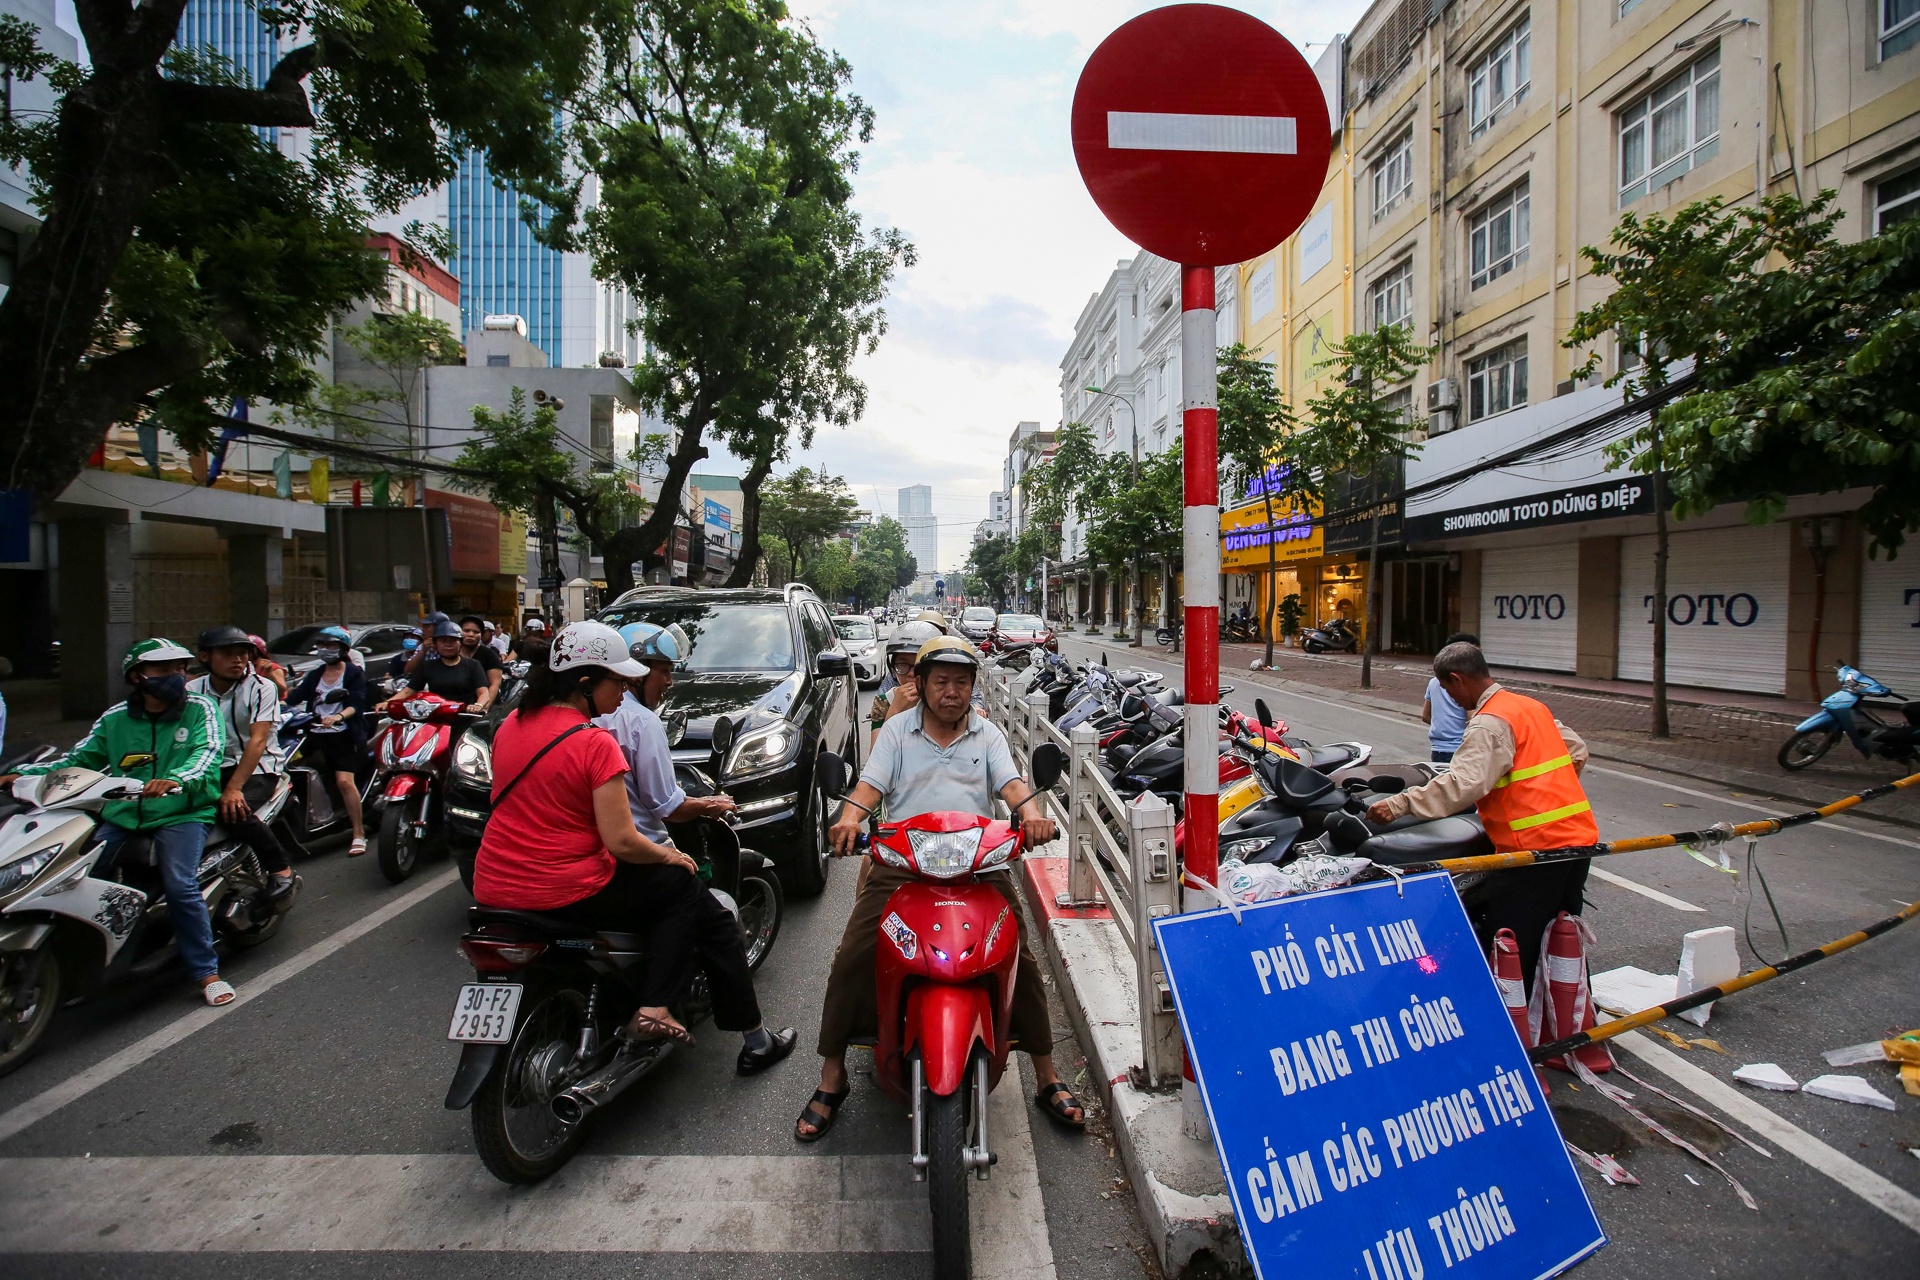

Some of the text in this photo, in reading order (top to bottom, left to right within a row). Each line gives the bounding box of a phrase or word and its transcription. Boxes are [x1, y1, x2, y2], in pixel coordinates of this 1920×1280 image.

[1304, 229, 1329, 259] PHILIPS
[1444, 484, 1641, 531] SHOWROOM TOTO DŨNG ĐIỆP
[1494, 593, 1565, 620] TOTO
[1338, 866, 1350, 876] 50
[1250, 918, 1428, 995] PHỐ CÁT LINH
[455, 1013, 505, 1039] 2953
[1269, 993, 1465, 1097] ĐANG THI CÔNG
[1247, 1064, 1535, 1224] CẤM CÁC PHƯƠNG TIỆN
[1427, 1185, 1517, 1268] THÔNG
